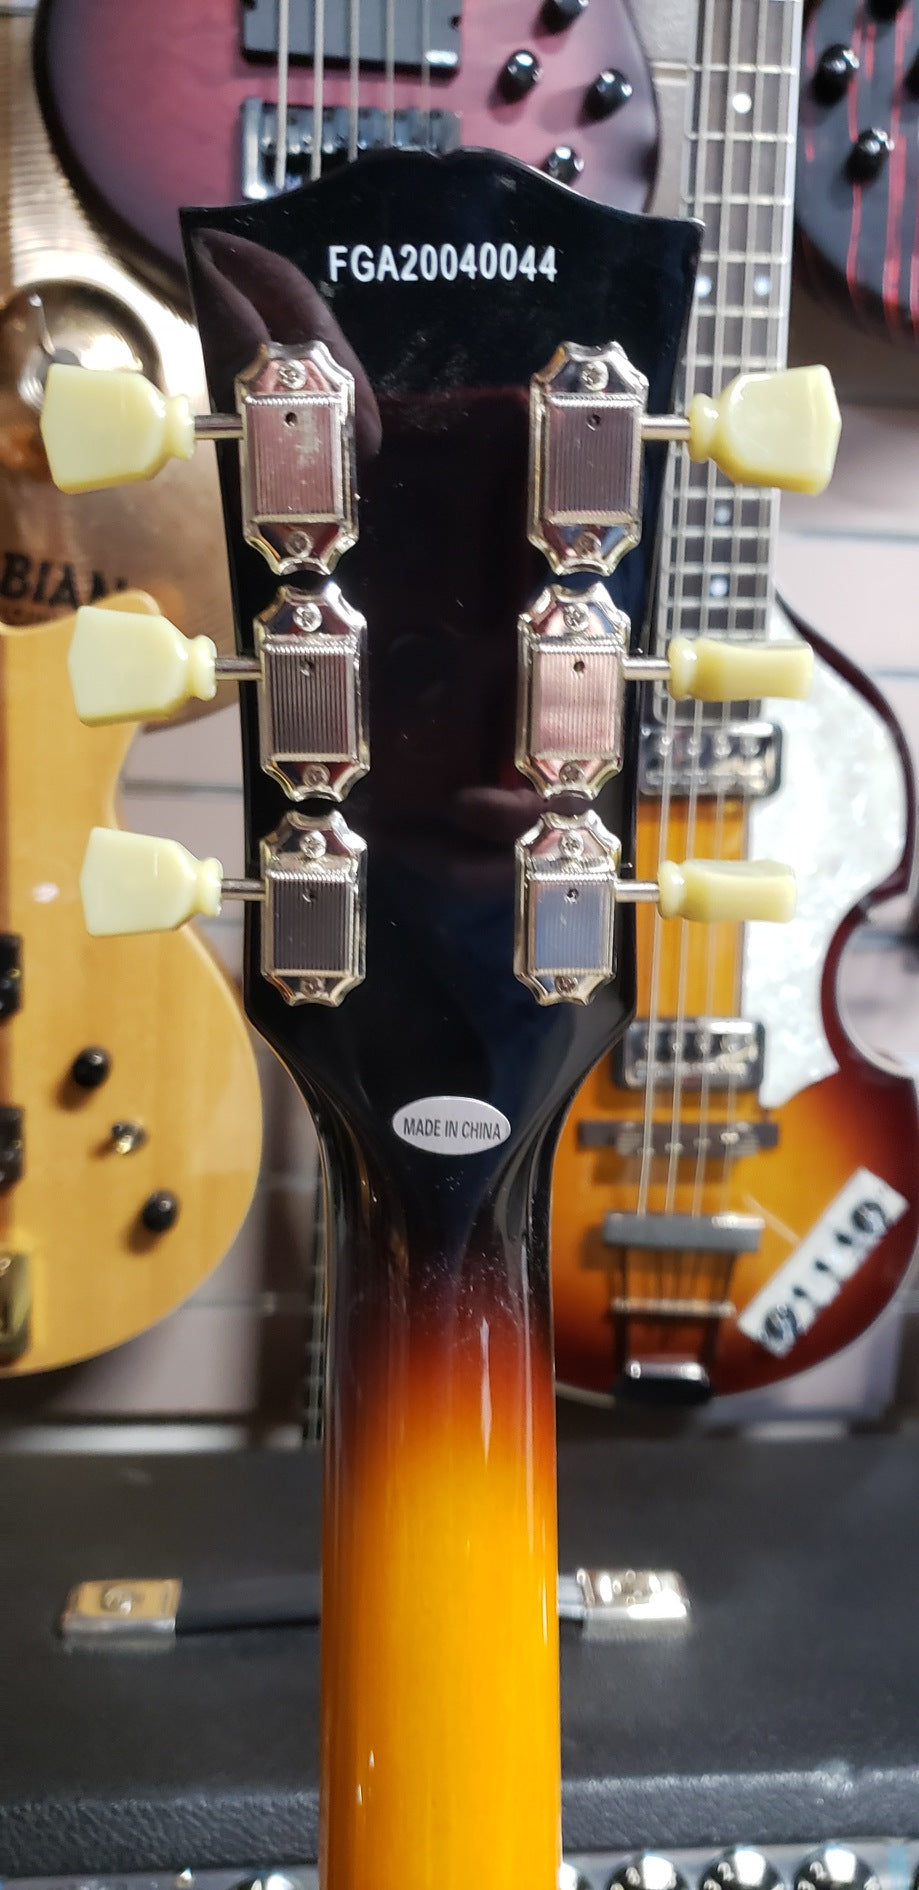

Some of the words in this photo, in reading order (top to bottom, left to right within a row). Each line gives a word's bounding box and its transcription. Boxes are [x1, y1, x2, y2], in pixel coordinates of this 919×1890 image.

[328, 242, 558, 283] FGA20040044
[403, 1117, 441, 1137] MADE
[445, 1119, 458, 1138] IN
[461, 1121, 501, 1140] CHINA
